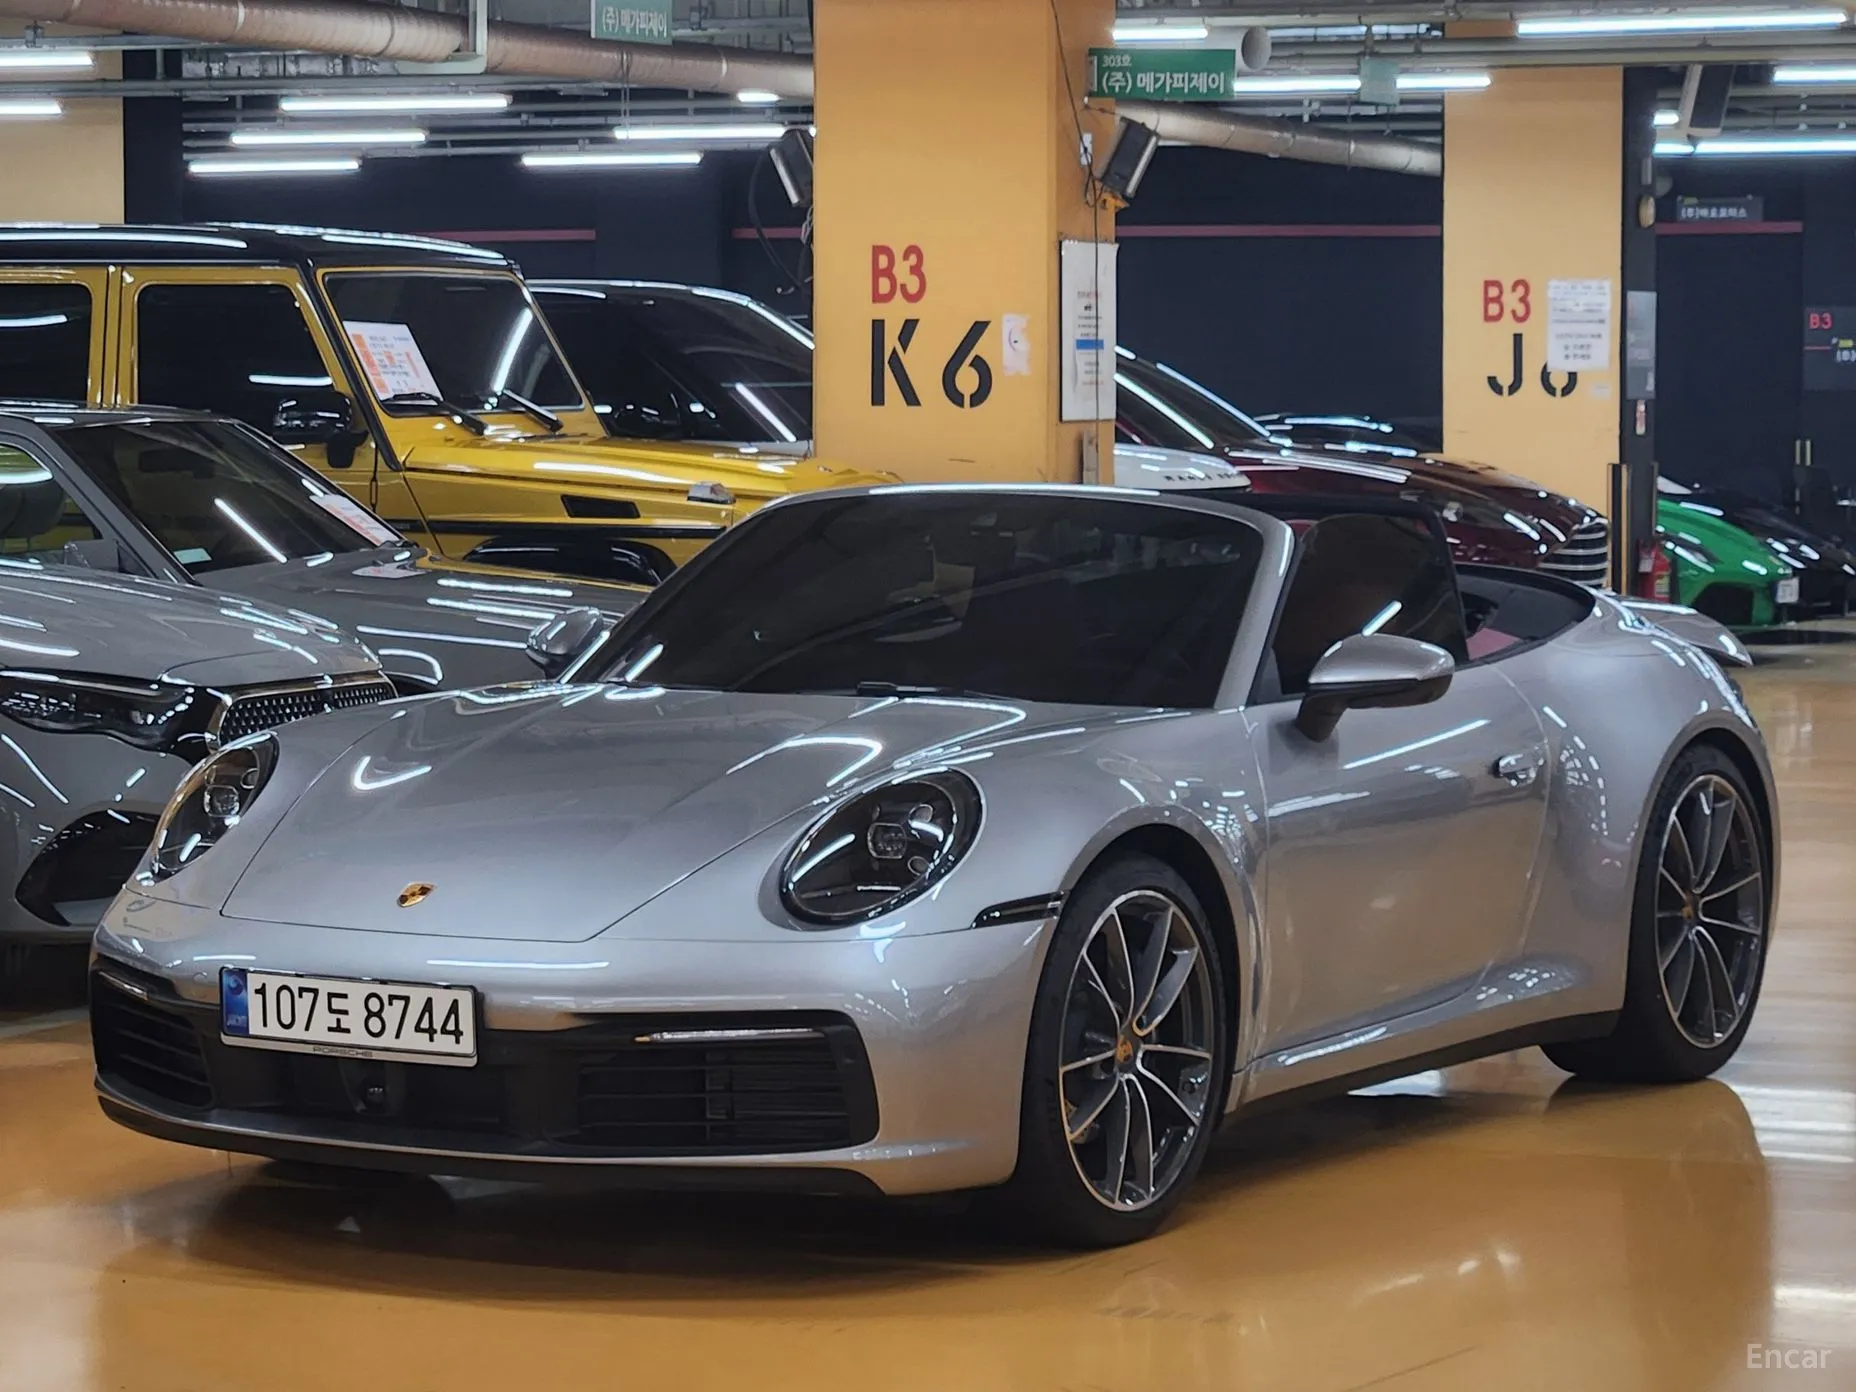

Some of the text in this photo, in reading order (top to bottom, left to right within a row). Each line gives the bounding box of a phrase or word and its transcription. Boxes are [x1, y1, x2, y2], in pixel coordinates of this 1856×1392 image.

[1137, 71, 1225, 93] 메가피제이
[872, 245, 926, 304] B3
[1484, 279, 1531, 323] B3
[1809, 312, 1832, 330] B3
[254, 982, 464, 1045] 107도 8744
